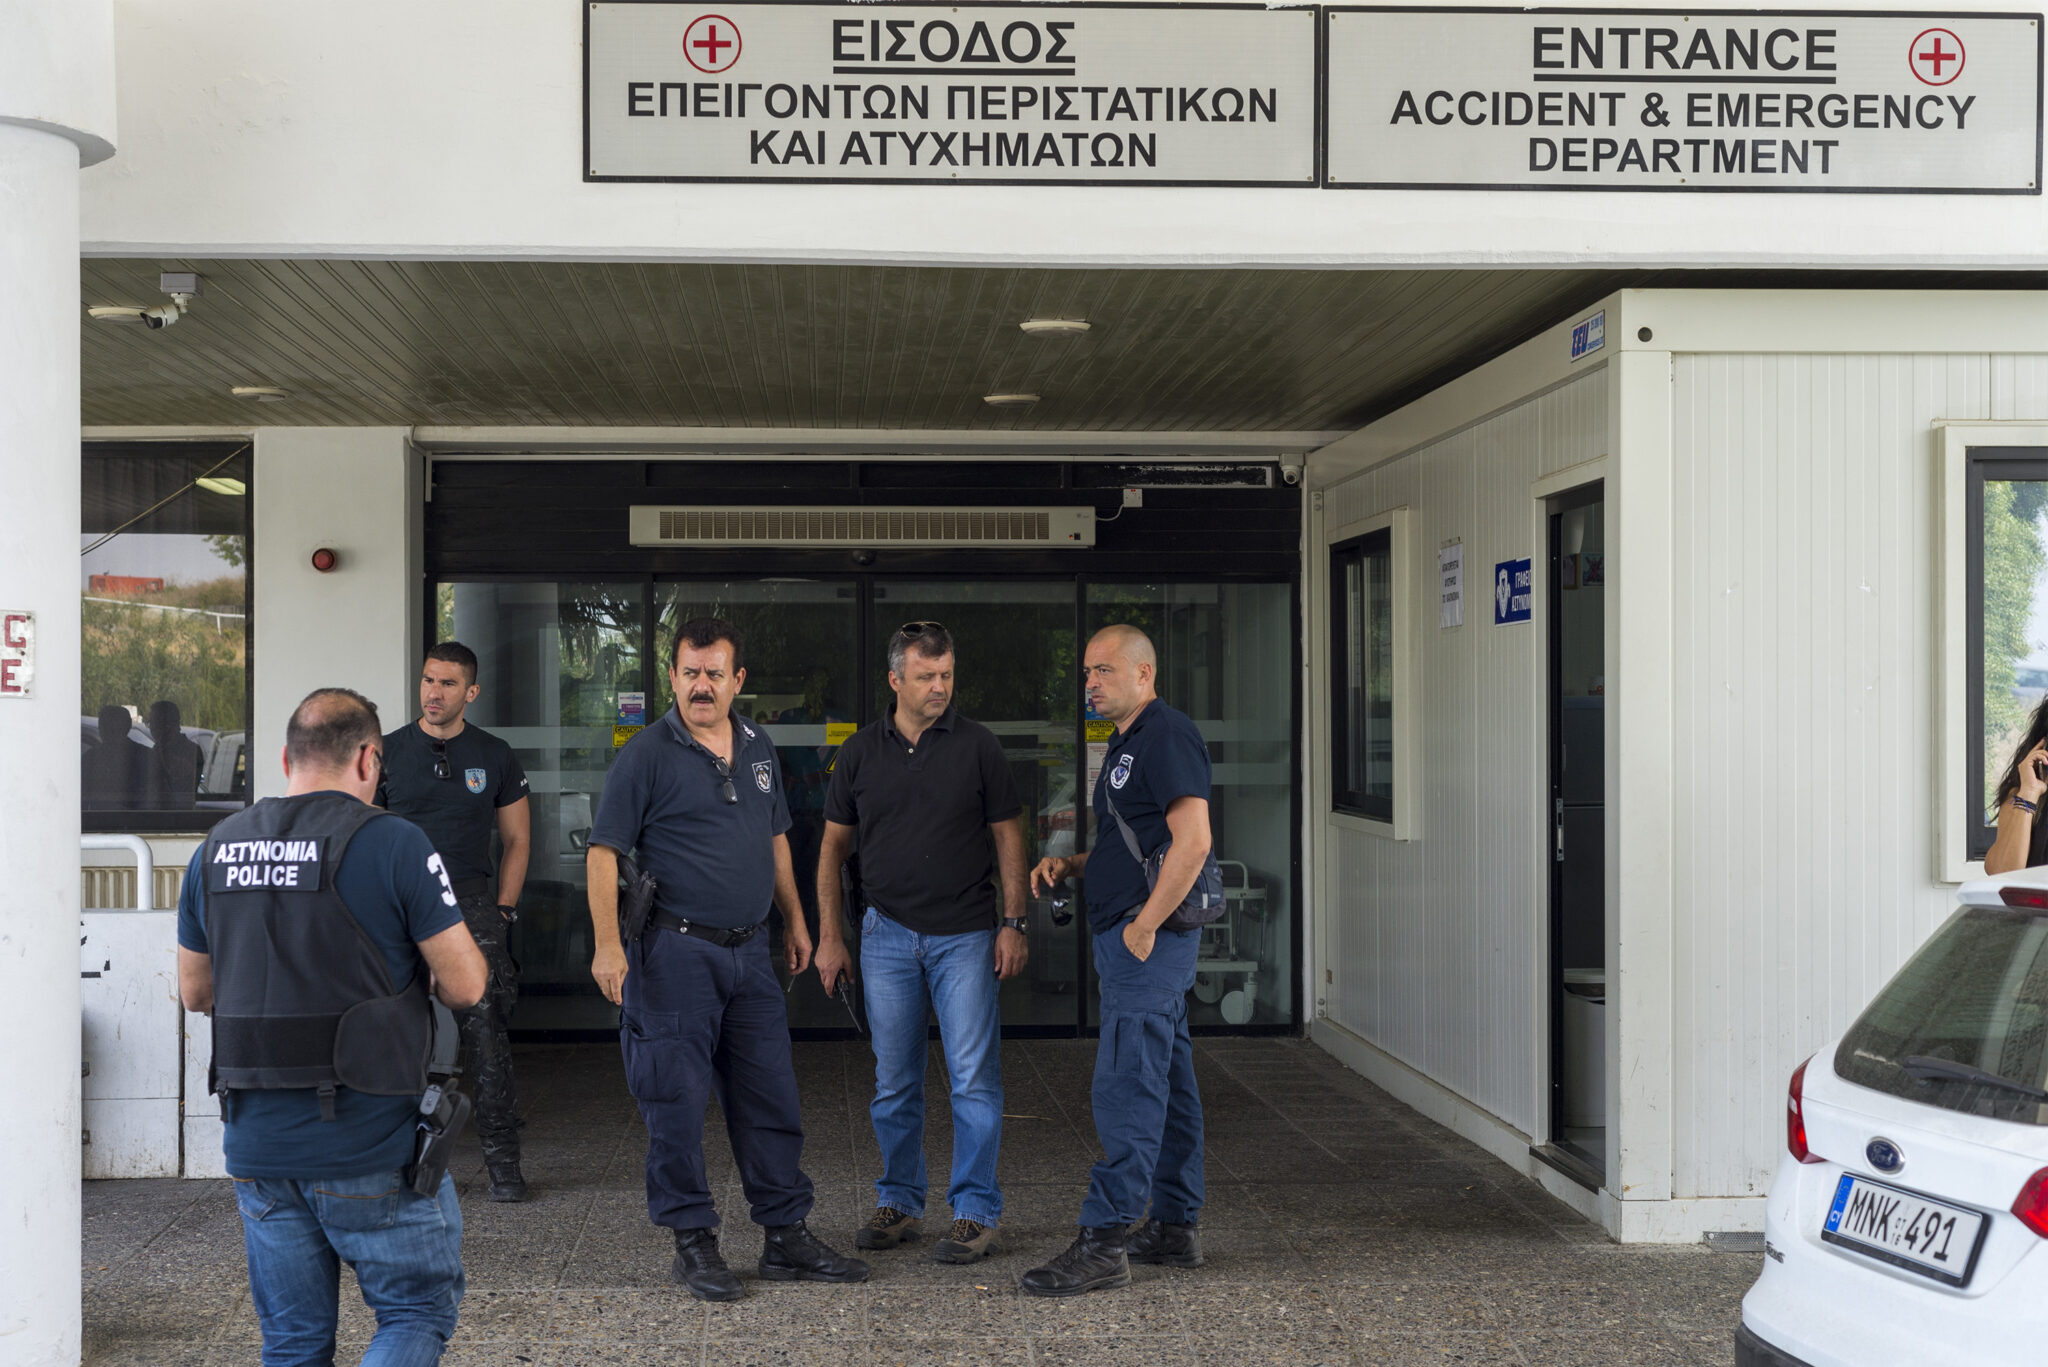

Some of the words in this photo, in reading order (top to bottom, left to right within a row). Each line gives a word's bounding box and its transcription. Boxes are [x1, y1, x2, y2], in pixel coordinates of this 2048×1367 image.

[833, 20, 1076, 63] ΕΙΣΟΔΟΣ
[1534, 27, 1836, 71] ENTRANCE
[628, 82, 929, 120] ΕΠΕΙΓΟΝΤΩΝ
[948, 85, 1277, 122] ΠΕΡΙΣΤΑΤΙΚΩΝ
[1390, 91, 1626, 127] ACCIDENT
[1641, 93, 1671, 128] &
[1687, 93, 1976, 129] EMERGENCY
[751, 131, 826, 165] ΚΑΙ
[839, 131, 1156, 167] ΑΤΥΧΗΜΑΤΩΝ
[1529, 137, 1839, 174] DEPARTMENT
[213, 840, 318, 863] ΑΣΤΥΝΟΜΙΑ
[226, 864, 298, 888] POLICE
[1830, 1210, 1842, 1223] CY
[1845, 1188, 1900, 1242] MNK
[1904, 1207, 1957, 1262] 491
